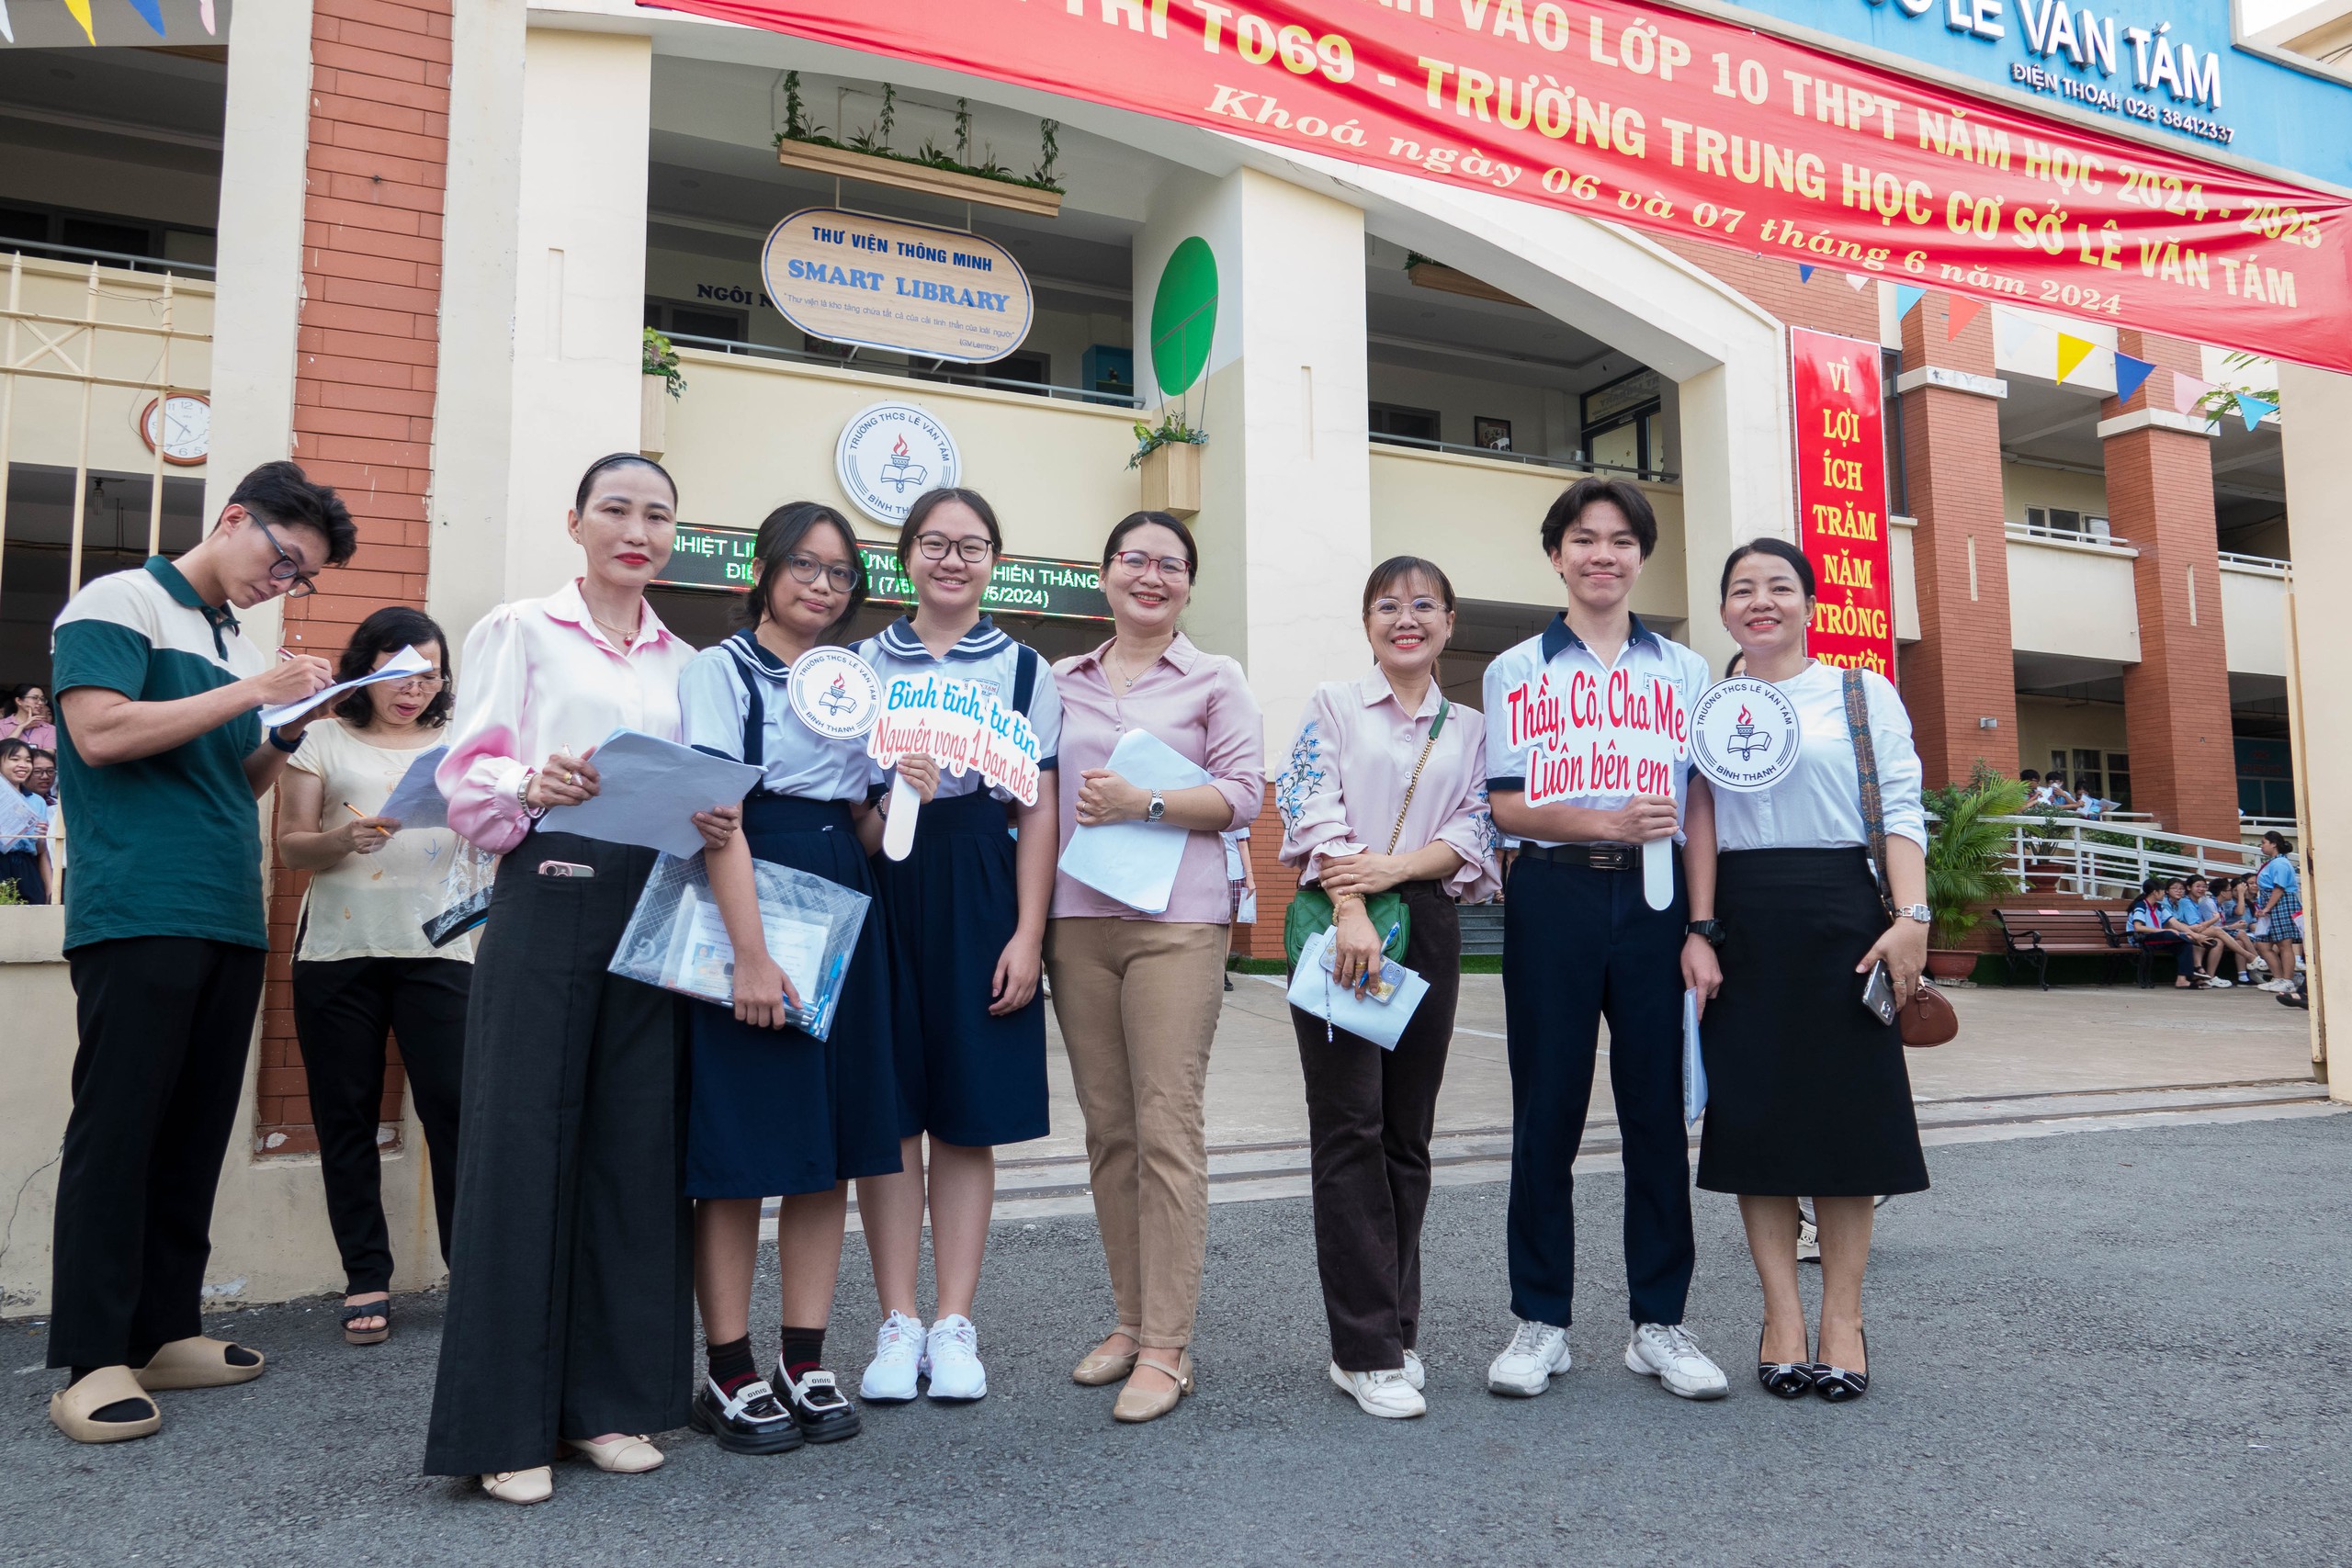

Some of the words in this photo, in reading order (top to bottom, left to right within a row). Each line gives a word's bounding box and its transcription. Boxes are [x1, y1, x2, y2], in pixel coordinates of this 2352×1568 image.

[2122, 20, 2222, 111] TÁM
[2011, 61, 2059, 92] ĐIỆN
[2122, 96, 2159, 121] 028
[2162, 107, 2236, 144] 38412337
[1193, 0, 1355, 84] T069
[1418, 55, 1646, 160] TRƯỜNG
[1661, 117, 1826, 202] TRUNG
[1842, 163, 1932, 226] HỌC
[1946, 190, 2004, 241] CƠ
[2011, 198, 2068, 256] SỞ
[2077, 219, 2124, 271] LÊ
[2138, 235, 2211, 290] VĂN
[2219, 254, 2299, 309] TÁM
[1589, 16, 1691, 83] LỚP
[1712, 51, 1769, 105] 10
[1783, 69, 1901, 141] THPT
[1917, 110, 2010, 172] NĂM
[2025, 141, 2104, 196] HỌC
[2117, 164, 2209, 221] 2024
[2239, 197, 2323, 249] 2025
[1204, 84, 1368, 148] Khoá
[1388, 134, 1522, 189] ngày
[1542, 166, 1601, 201] 06
[1617, 187, 1674, 220] và
[1692, 201, 1747, 235] 07
[1759, 219, 1891, 273] tháng
[1904, 249, 1928, 275] 6
[1939, 261, 2028, 296] năm
[2039, 279, 2122, 316] 2024
[812, 226, 845, 245] THƯ
[851, 233, 888, 254] VIỆN
[897, 242, 947, 265] THÔNG
[953, 253, 992, 272] MINH
[697, 284, 752, 306] NGÔI
[787, 258, 885, 292] SMART
[896, 276, 1011, 313] LIBRARY
[829, 301, 842, 310] kho
[1826, 355, 1851, 394] VÌ
[850, 417, 878, 450] TRƯỜNG
[878, 412, 906, 422] THCS
[937, 440, 950, 462] TÁM
[1822, 407, 1860, 447] LỢI
[1822, 448, 1863, 492] ÍCH
[867, 494, 893, 512] BÌNH
[1813, 501, 1878, 542] TRĂM
[1039, 569, 1100, 590] THẮNG
[1823, 548, 1872, 590] NĂM
[1815, 590, 1887, 640] TRỒNG
[827, 655, 847, 663] THCS
[887, 676, 937, 711] Bình
[942, 681, 984, 725] tĩnh,
[989, 701, 1011, 738] tự
[1013, 717, 1038, 761] tin
[1507, 672, 1566, 752] Thầy,
[1570, 670, 1603, 731] Cô,
[1608, 668, 1652, 730] Cha
[1654, 679, 1688, 755] Mẹ
[1697, 693, 1723, 726] TRƯỜNG
[1722, 683, 1747, 694] THCS
[934, 733, 967, 774] vọng
[968, 728, 981, 766] 1
[982, 730, 1007, 784] bạn
[1009, 761, 1037, 804] nhé
[1530, 743, 1583, 802] Luôn
[1590, 739, 1632, 790] bên
[1636, 757, 1671, 796] em
[1716, 765, 1740, 781] BÌNH
